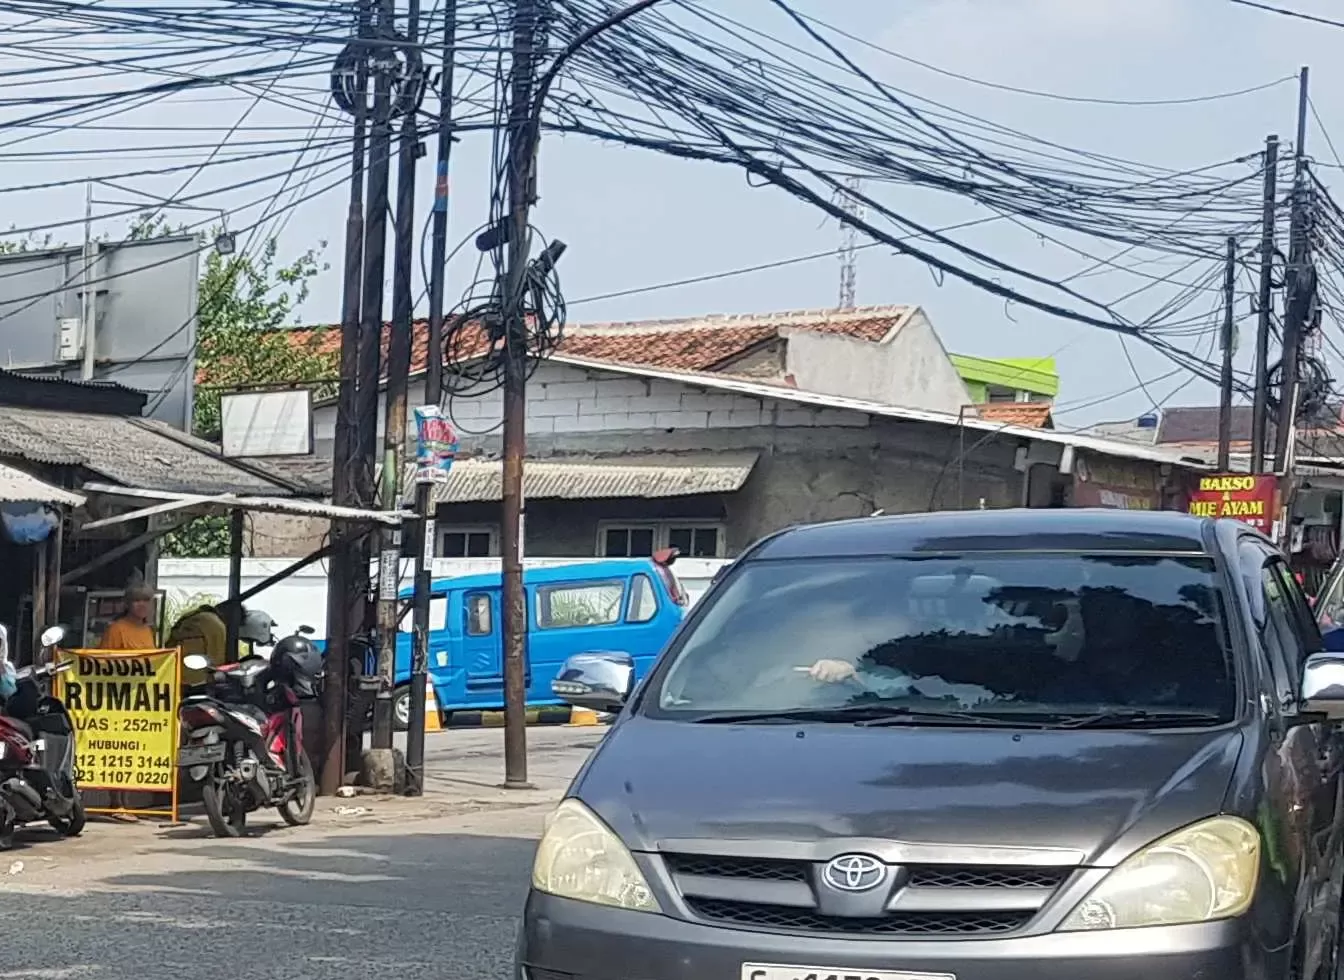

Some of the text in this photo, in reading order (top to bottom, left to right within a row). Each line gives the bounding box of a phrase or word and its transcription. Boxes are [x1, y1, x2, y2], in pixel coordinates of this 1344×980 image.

[1199, 476, 1255, 491] BAKSO
[1189, 501, 1265, 517] MIE AYAM
[78, 655, 156, 677] DIJUAL
[64, 681, 171, 712] RUMAH
[88, 740, 140, 751] HUBUNGI
[100, 755, 133, 768] 1215
[137, 756, 170, 769] 3144
[99, 770, 132, 783] 1107
[135, 772, 169, 785] 0220
